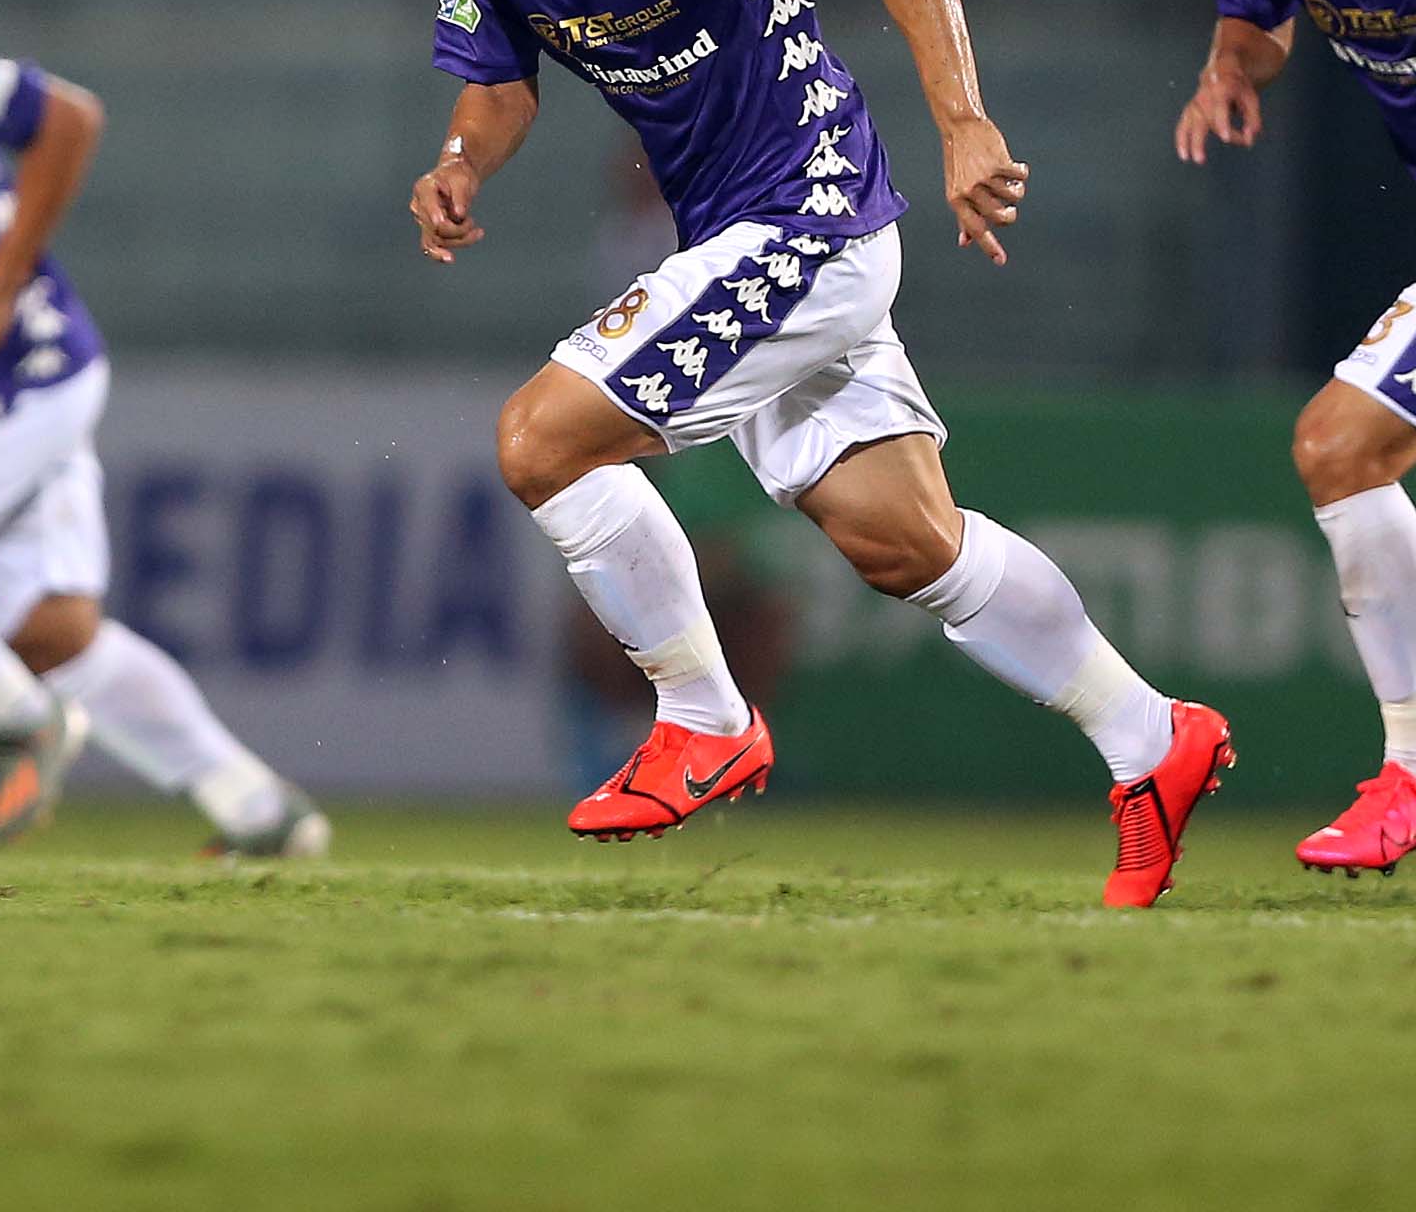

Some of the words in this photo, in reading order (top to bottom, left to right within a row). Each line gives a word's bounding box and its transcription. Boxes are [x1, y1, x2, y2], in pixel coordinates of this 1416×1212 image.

[559, 11, 613, 42] T&T
[615, 0, 673, 32] GROUP
[124, 453, 529, 673] EDIA
